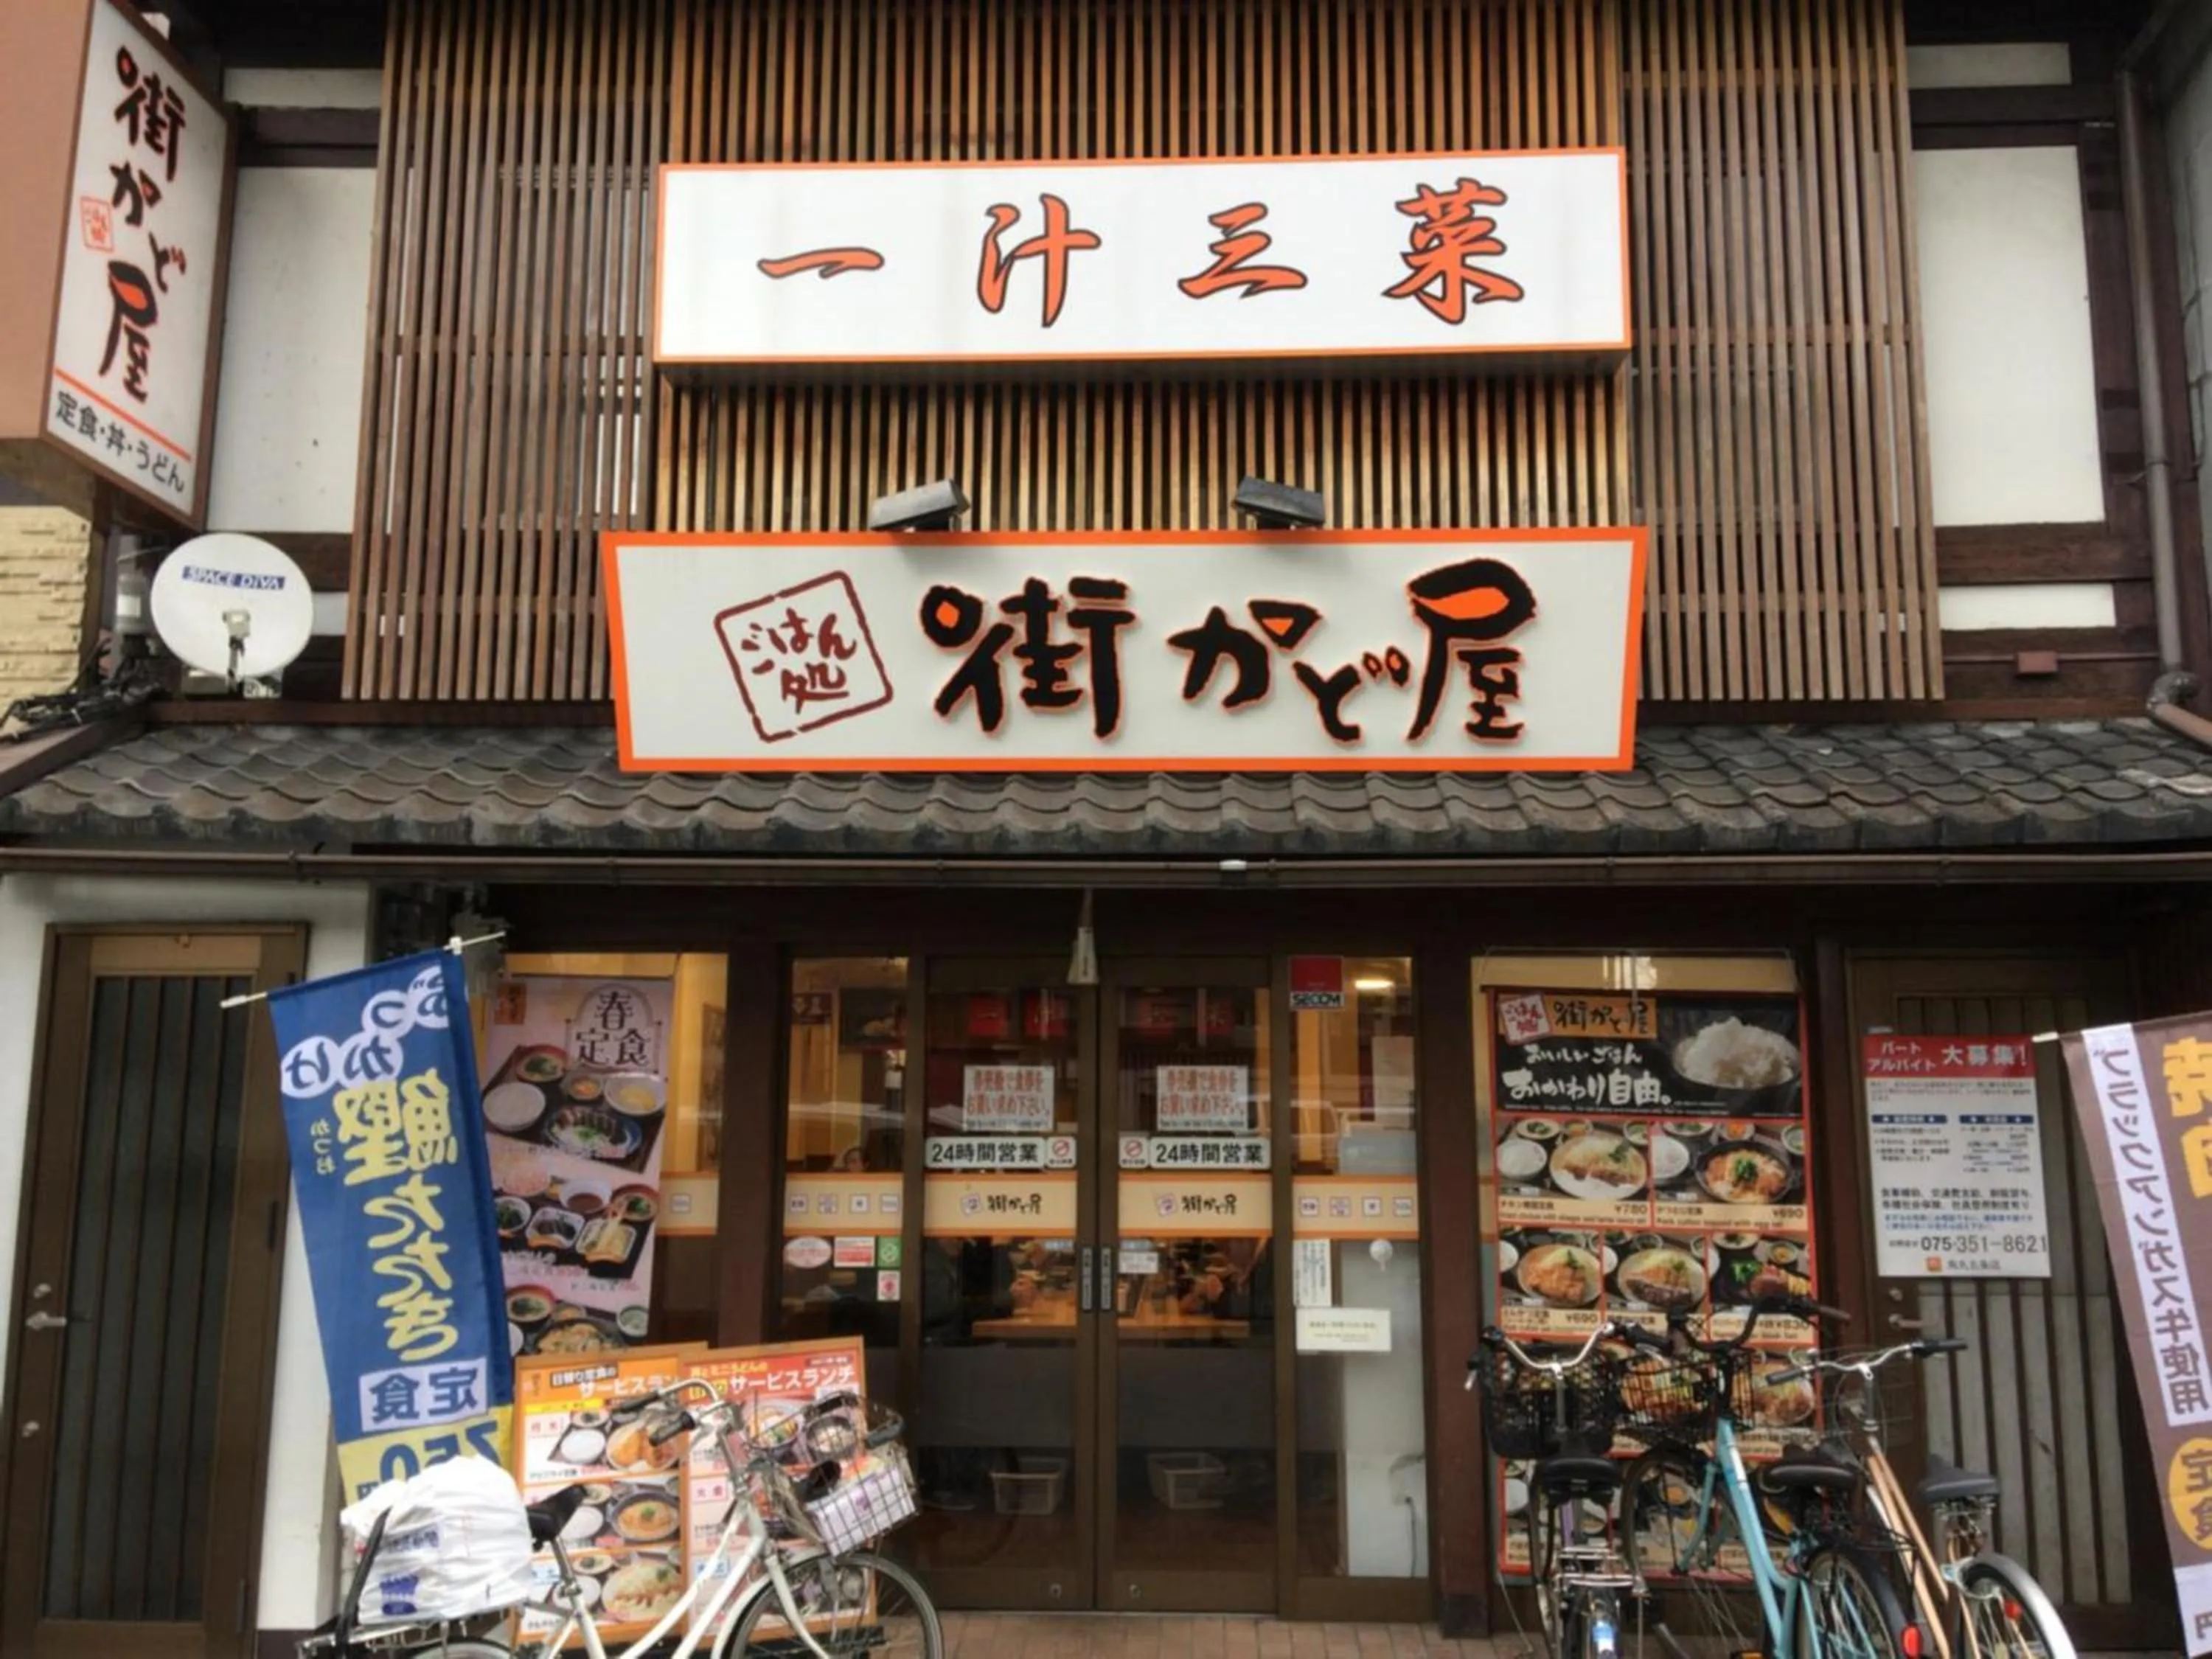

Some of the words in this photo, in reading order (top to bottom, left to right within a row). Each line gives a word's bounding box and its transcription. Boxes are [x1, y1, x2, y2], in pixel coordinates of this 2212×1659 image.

[99, 46, 187, 403] 街かど屋
[757, 178, 1524, 327] 一汁三菜
[56, 391, 185, 493] 定食・丼・うどん
[741, 606, 858, 675] ごはん
[920, 558, 1537, 745] 街かど屋
[594, 991, 634, 1032] 春
[1293, 993, 1340, 1005] SECOM
[1553, 999, 1649, 1035] 街かど屋
[575, 1027, 651, 1068] 定食
[1868, 1058, 1936, 1072] アルバイト
[1882, 1042, 1921, 1055] パート
[931, 1142, 1039, 1164] 24時間営業
[1155, 1144, 1263, 1164] 24時間営業
[730, 1365, 855, 1394] サービスランチ
